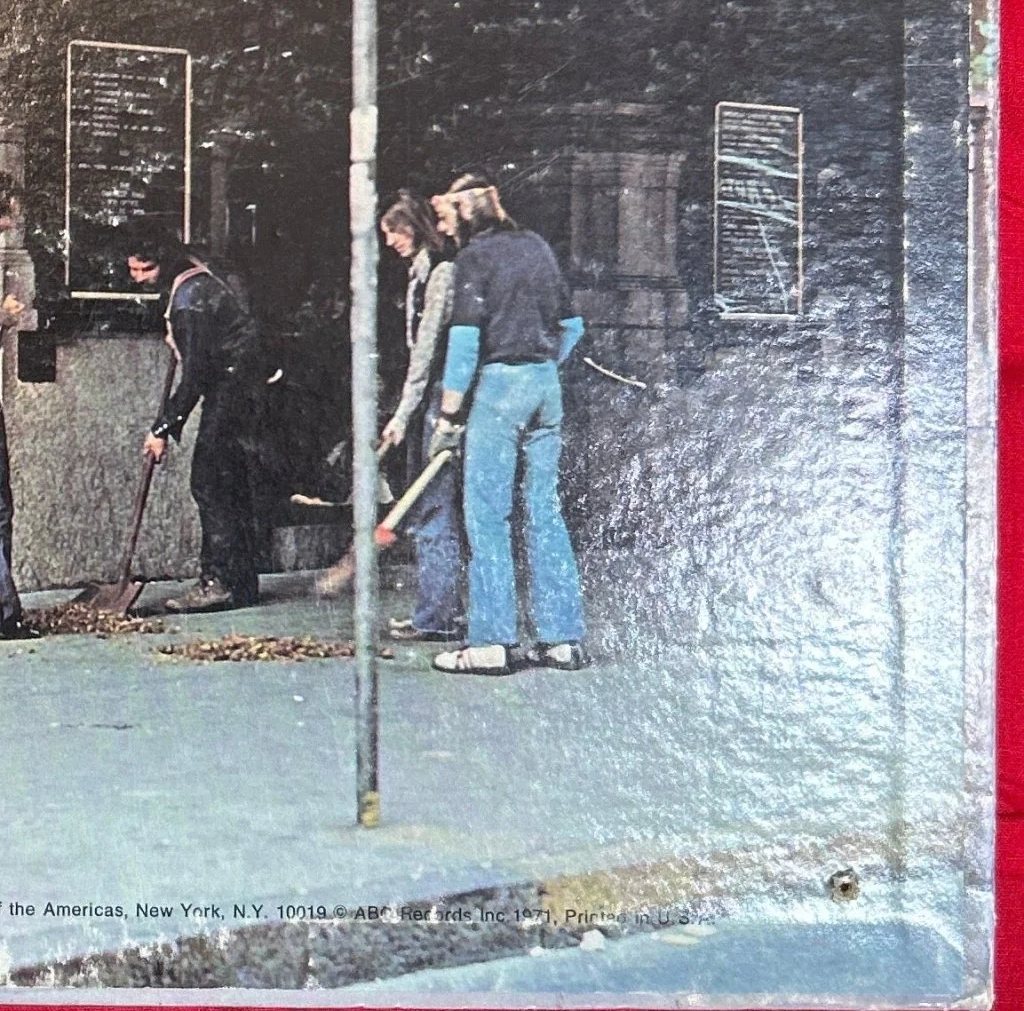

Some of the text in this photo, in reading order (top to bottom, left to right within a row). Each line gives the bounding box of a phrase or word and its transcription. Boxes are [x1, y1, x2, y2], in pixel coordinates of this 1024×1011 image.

[9, 901, 35, 917] the
[43, 902, 128, 920] Americas,
[136, 903, 173, 917] New
[180, 903, 224, 920] York,
[234, 904, 268, 919] N.Y.
[277, 905, 326, 919] 10019
